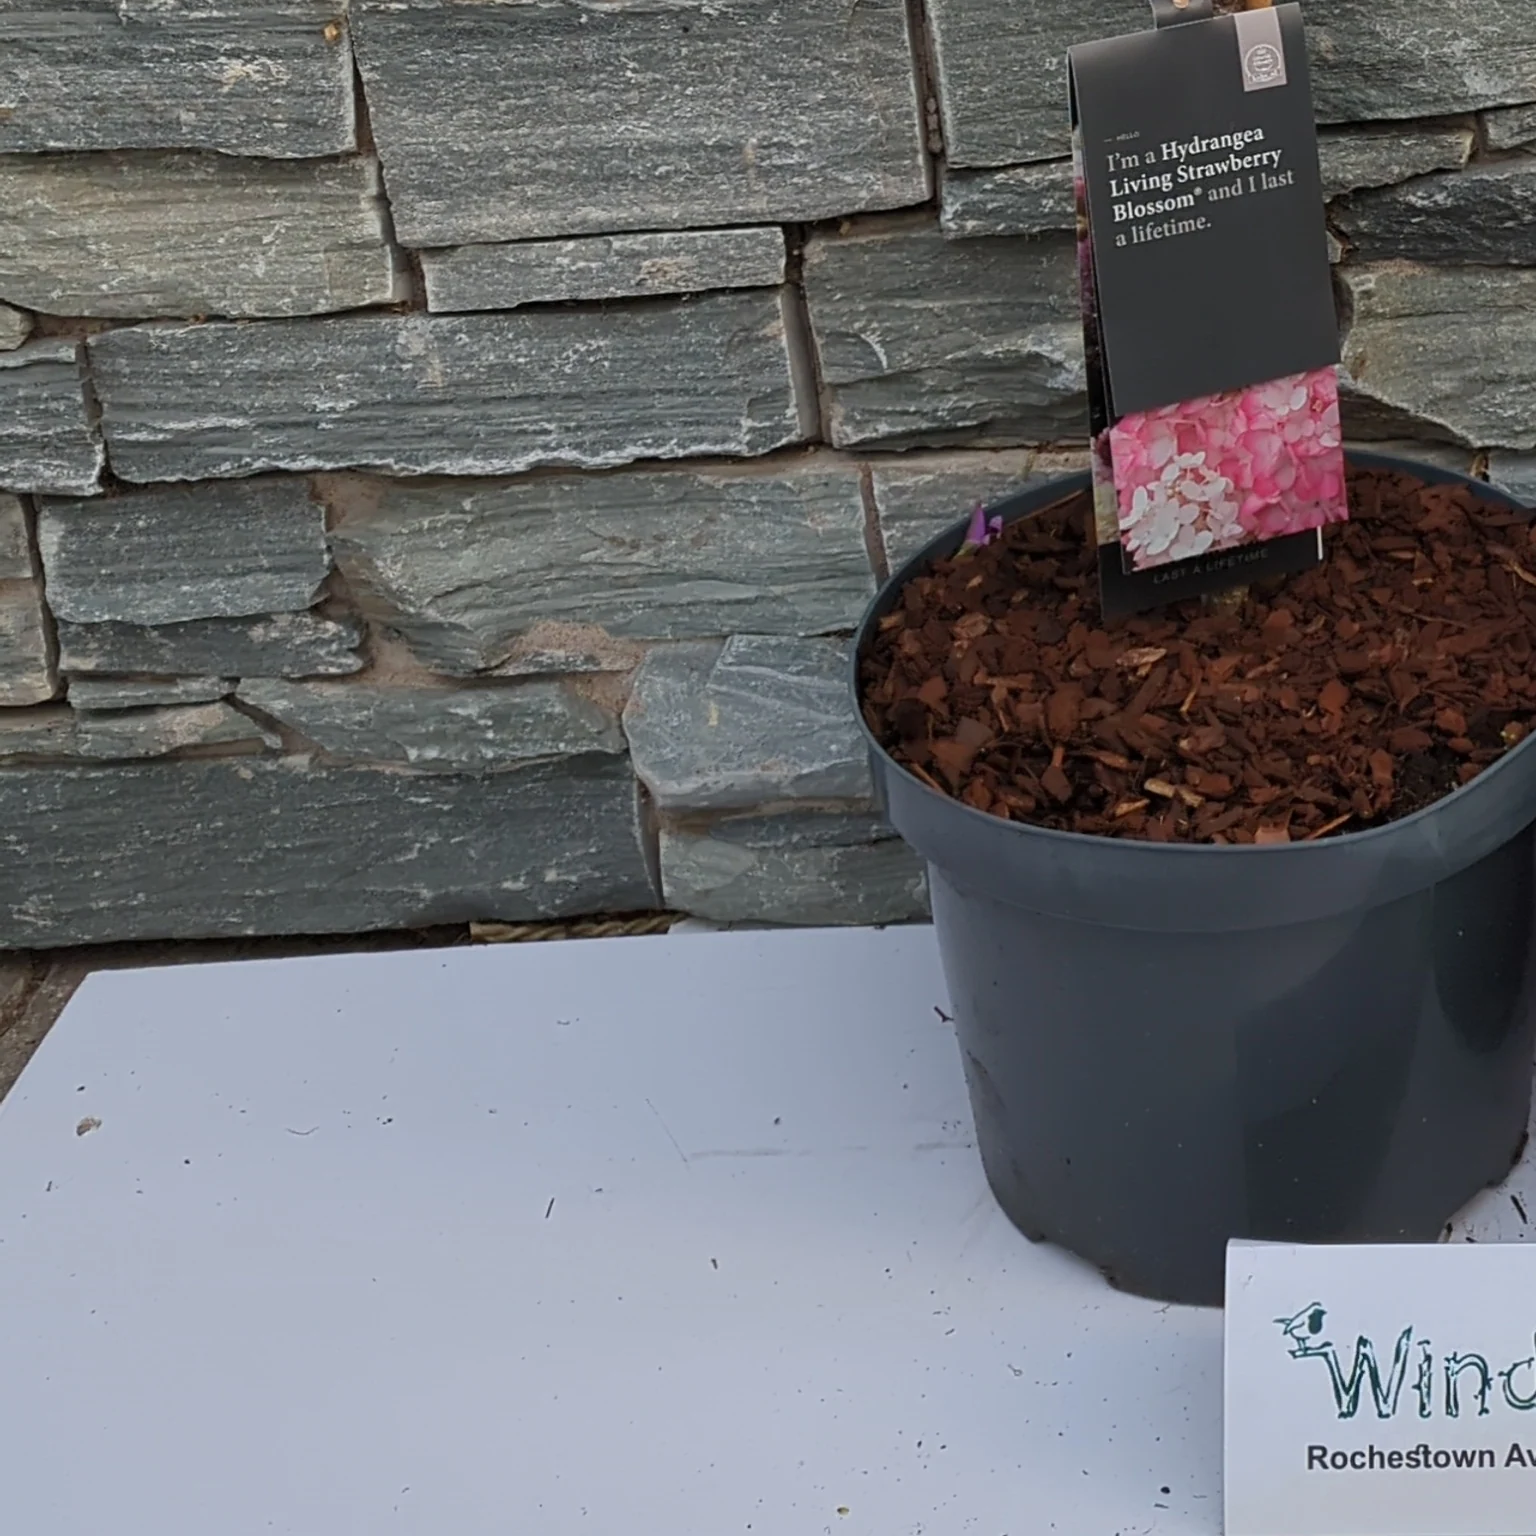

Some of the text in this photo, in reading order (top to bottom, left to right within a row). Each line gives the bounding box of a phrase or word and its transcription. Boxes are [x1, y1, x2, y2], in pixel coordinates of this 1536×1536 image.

[1107, 127, 1265, 172] I'm a Hydrangea
[1109, 148, 1282, 198] Living Strawberry
[1207, 179, 1243, 202] and
[1248, 176, 1258, 193] I
[1261, 169, 1295, 190] last
[1115, 216, 1212, 248] a lifetime.
[1153, 549, 1269, 584] LAST A LIFETIME
[1307, 1442, 1495, 1471] Rochestown
